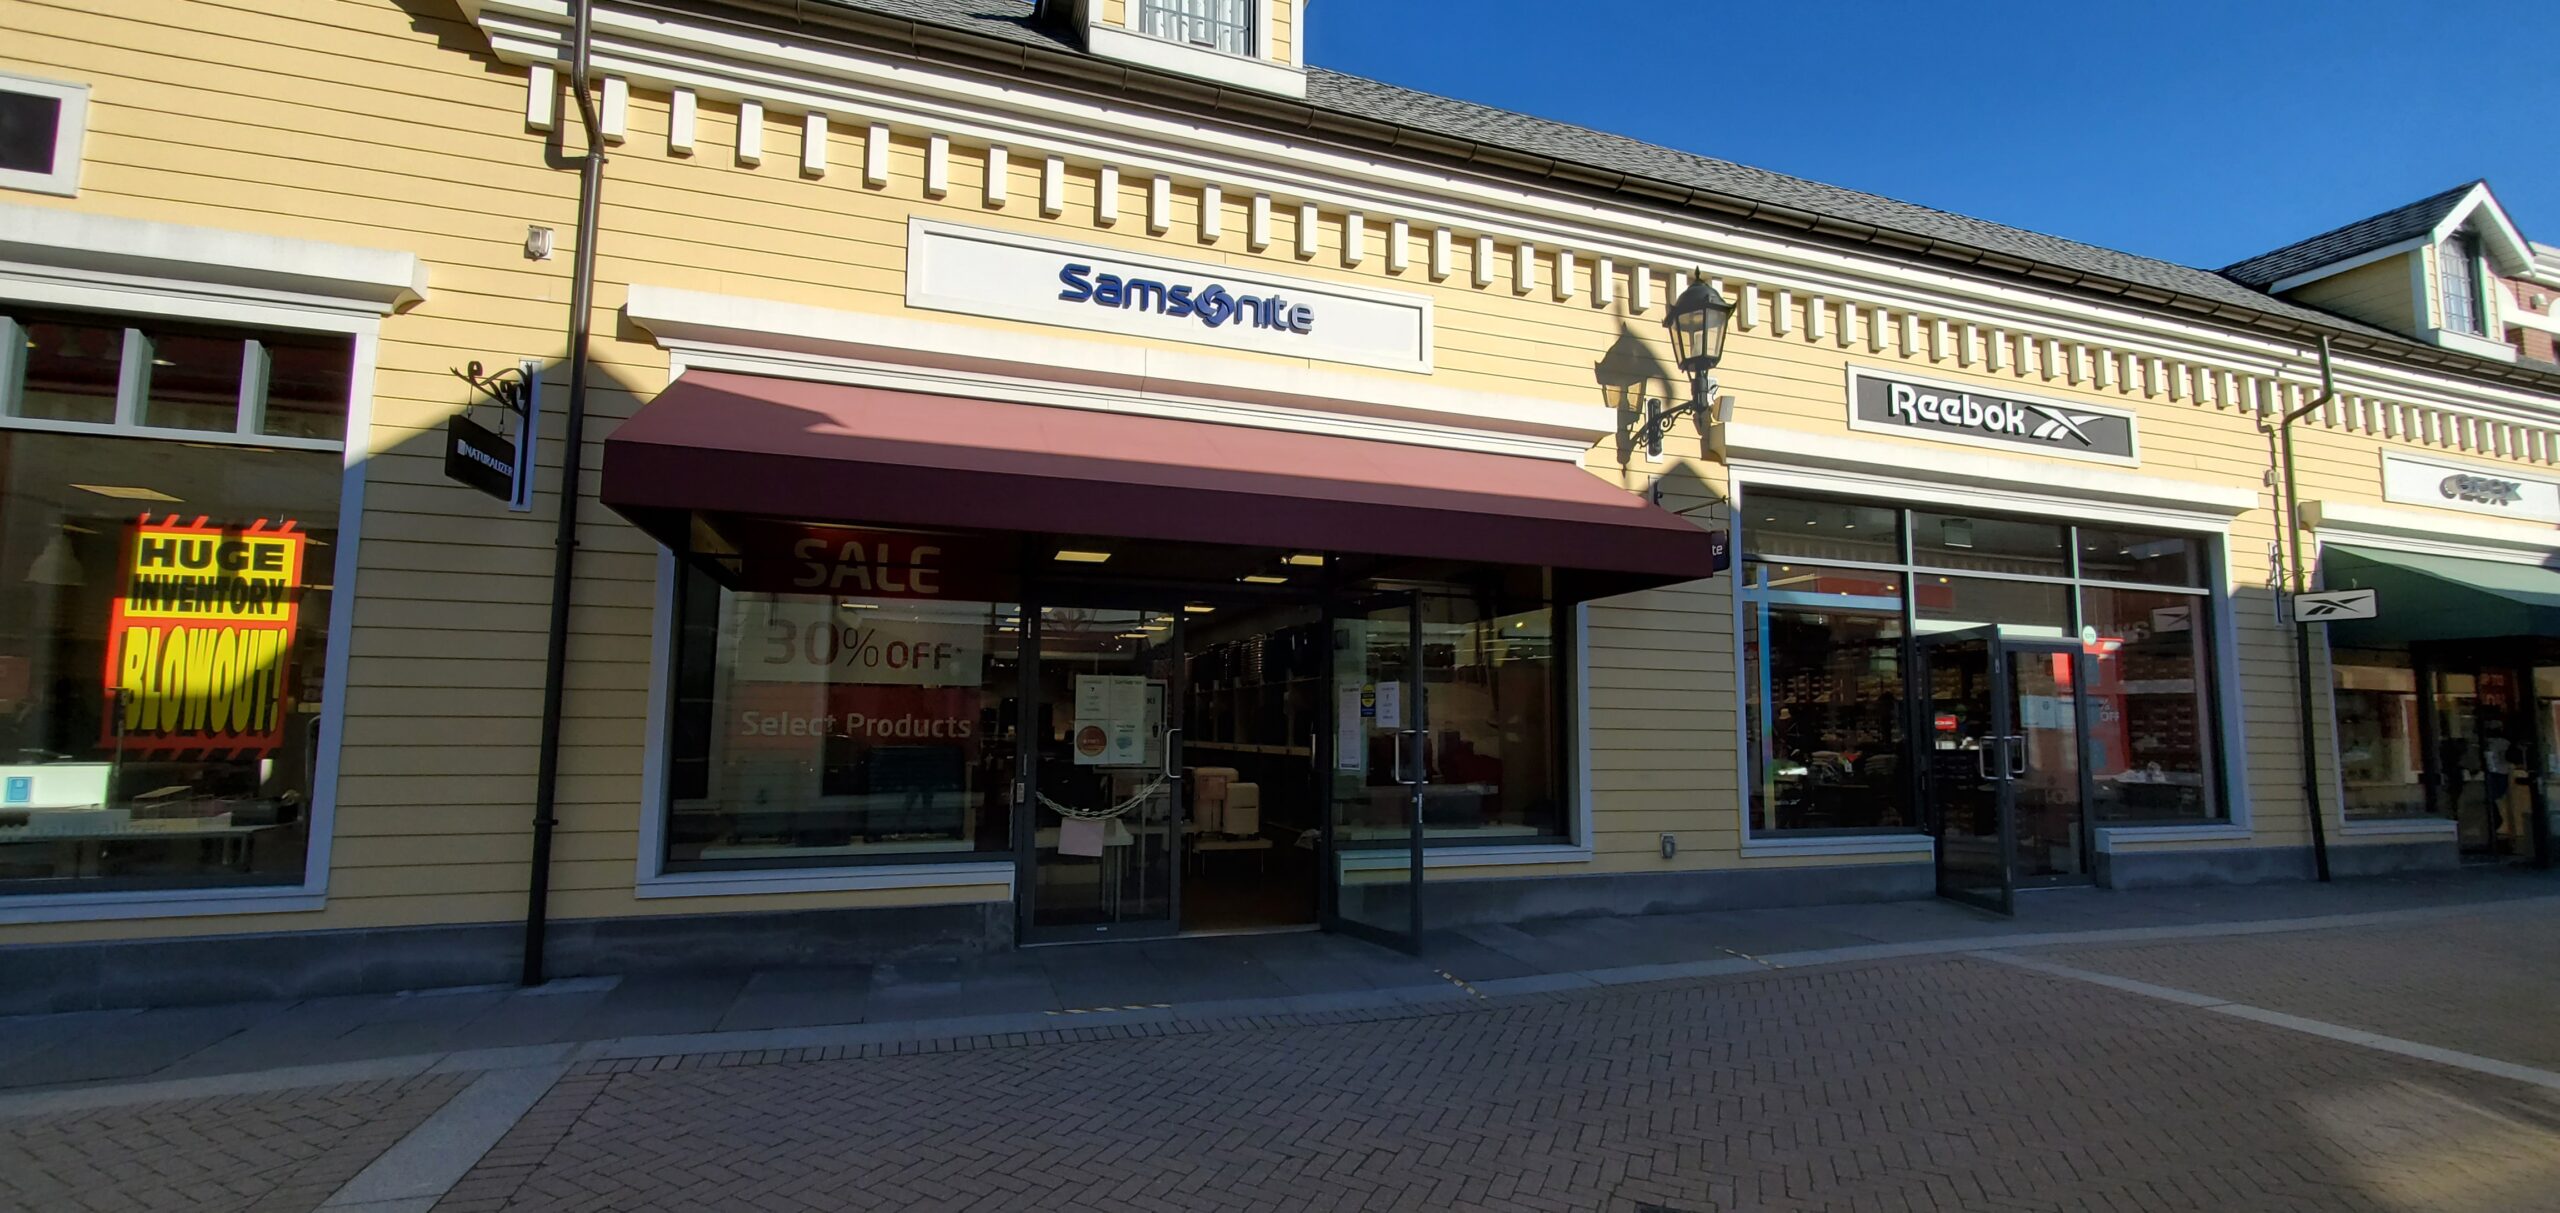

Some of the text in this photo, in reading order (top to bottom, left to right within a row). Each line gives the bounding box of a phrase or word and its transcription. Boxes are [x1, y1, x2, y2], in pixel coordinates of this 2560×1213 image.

[1058, 263, 1315, 335] Samsonite
[1888, 383, 2026, 435] Reebok
[139, 538, 285, 572] HUGE
[793, 538, 942, 594] SALE
[131, 574, 286, 615] INVENTORY
[764, 618, 879, 668] 30%
[119, 625, 289, 735] BLOWOUT!
[742, 711, 972, 739] Select Products
